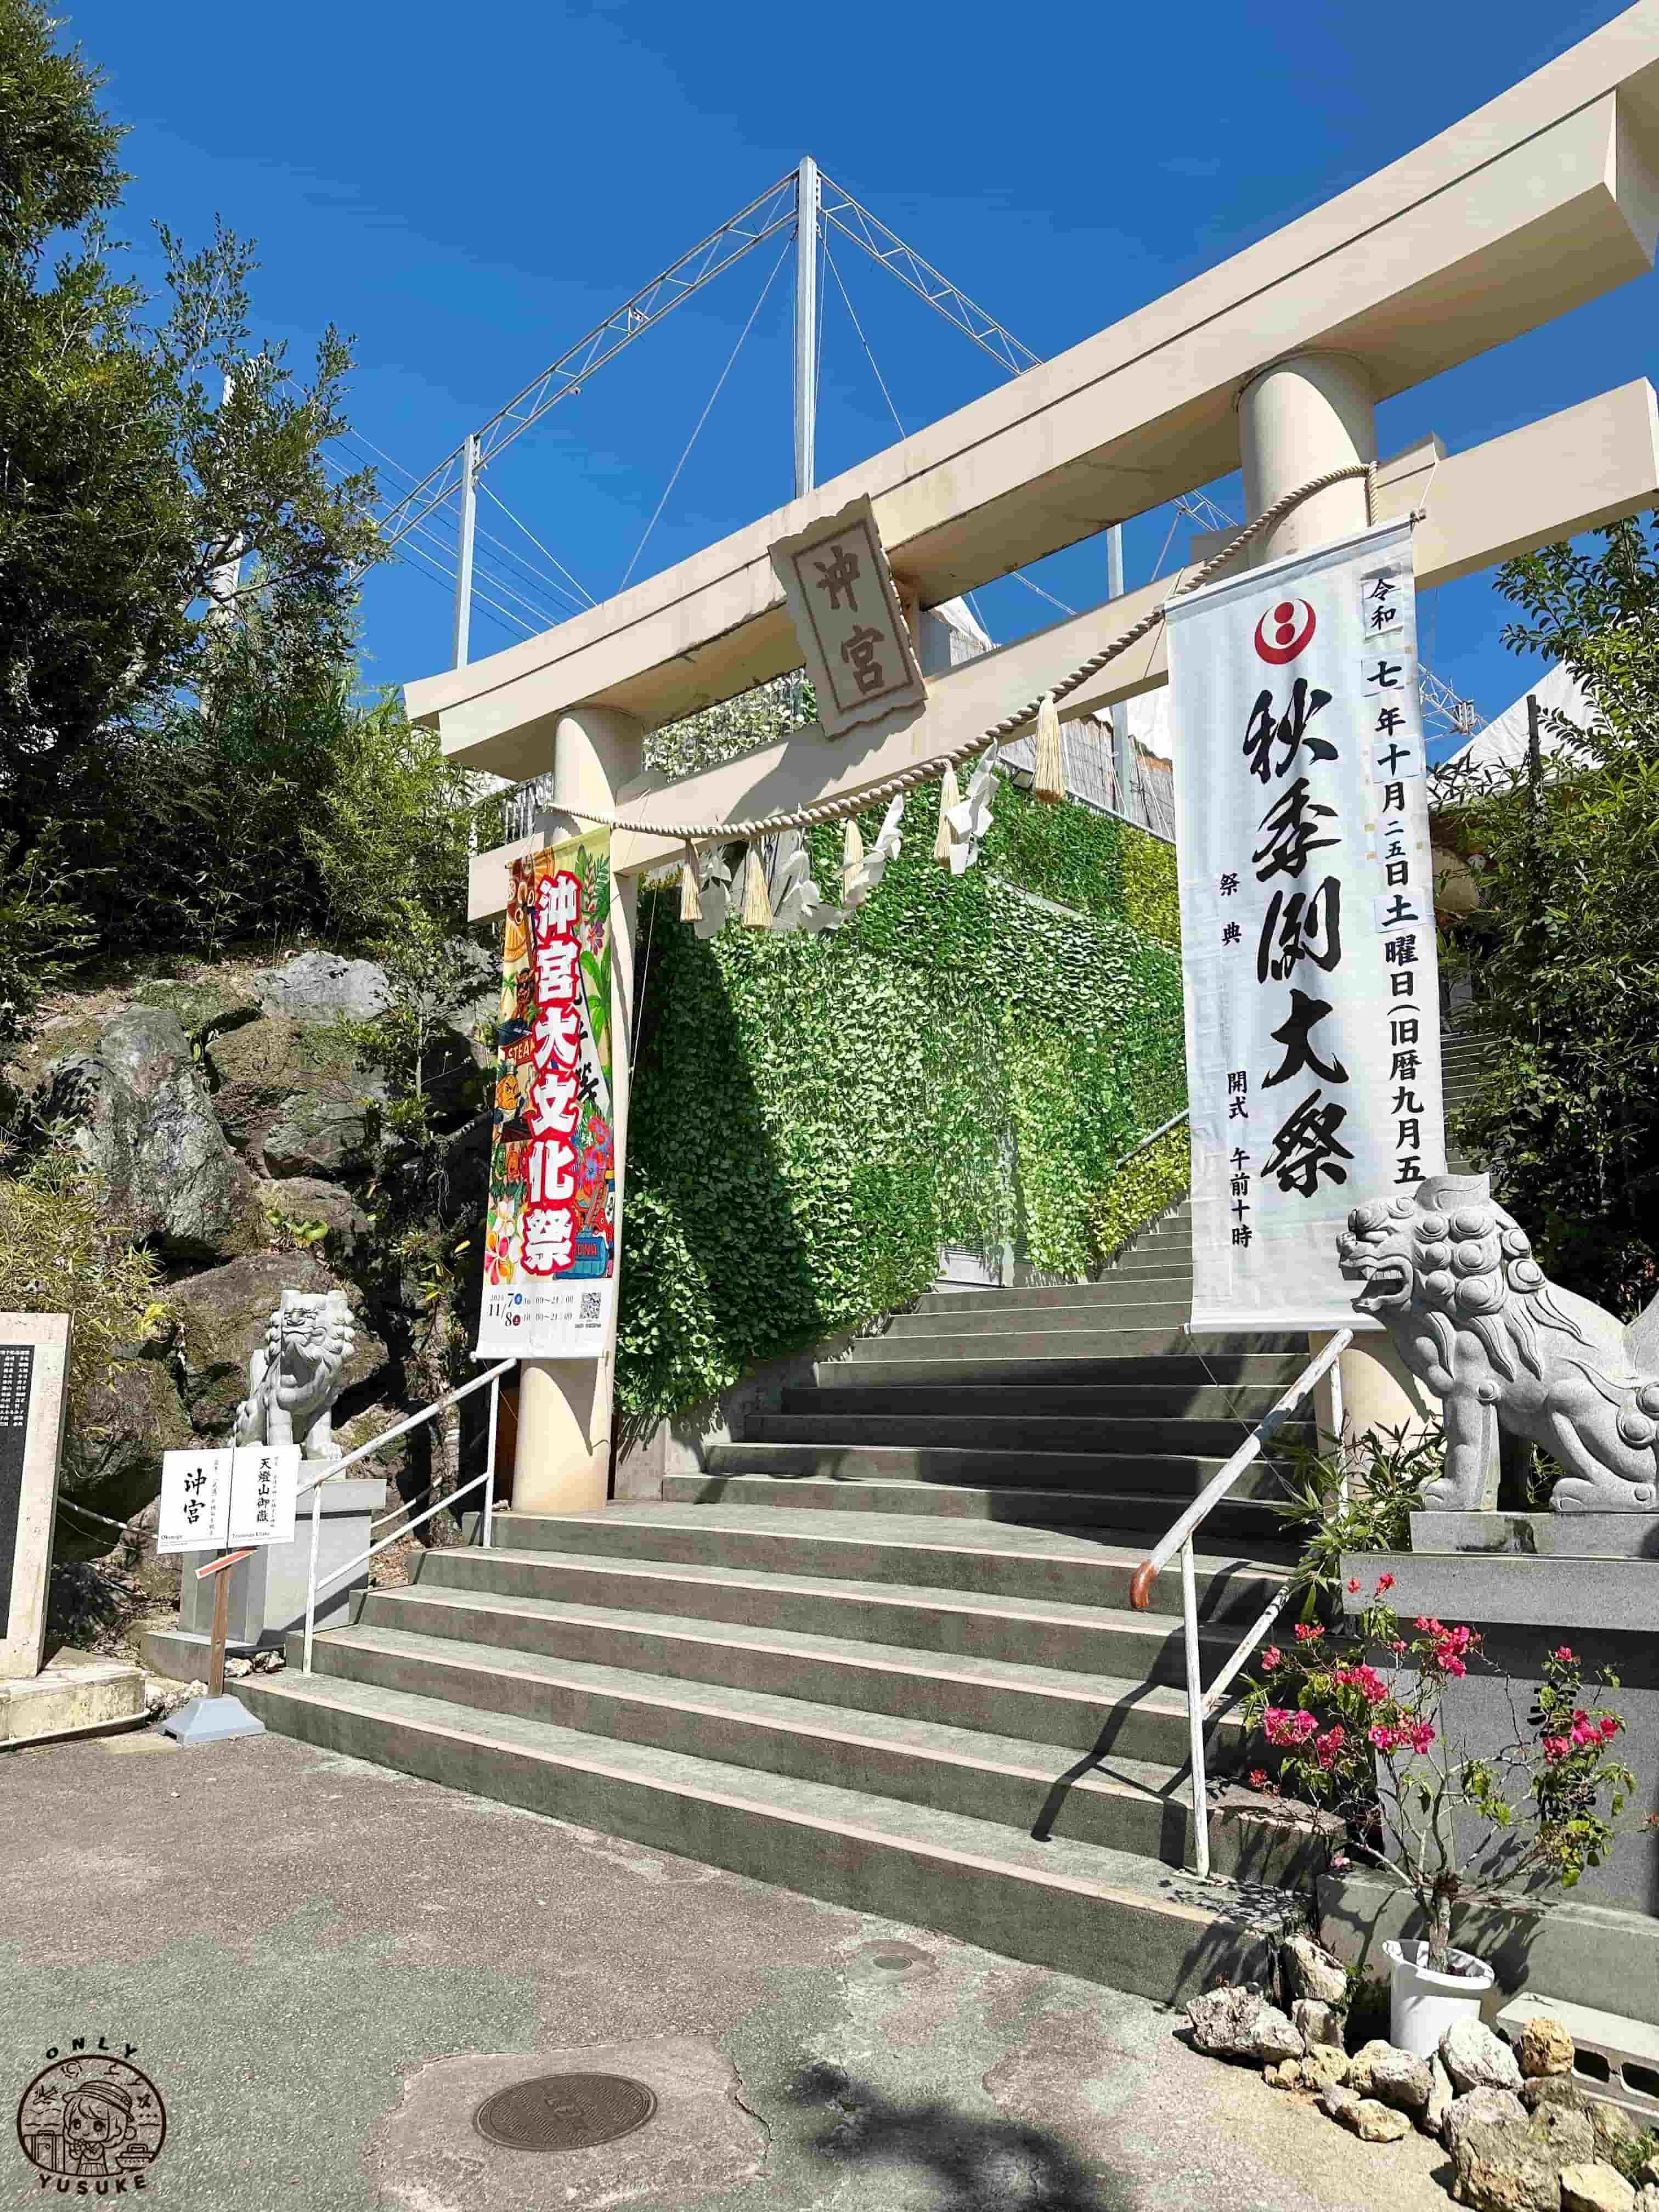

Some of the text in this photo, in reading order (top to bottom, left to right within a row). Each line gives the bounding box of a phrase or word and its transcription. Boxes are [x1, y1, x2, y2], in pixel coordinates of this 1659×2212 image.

[814, 545, 884, 695] 沖宮
[1243, 678, 1355, 1198] 秋季例大祭
[522, 871, 580, 1274] 沖宮大文化祭
[1227, 1071, 1249, 1120] 開式
[1229, 1147, 1252, 1249] 午前十時
[184, 1468, 207, 1524] 沖宮
